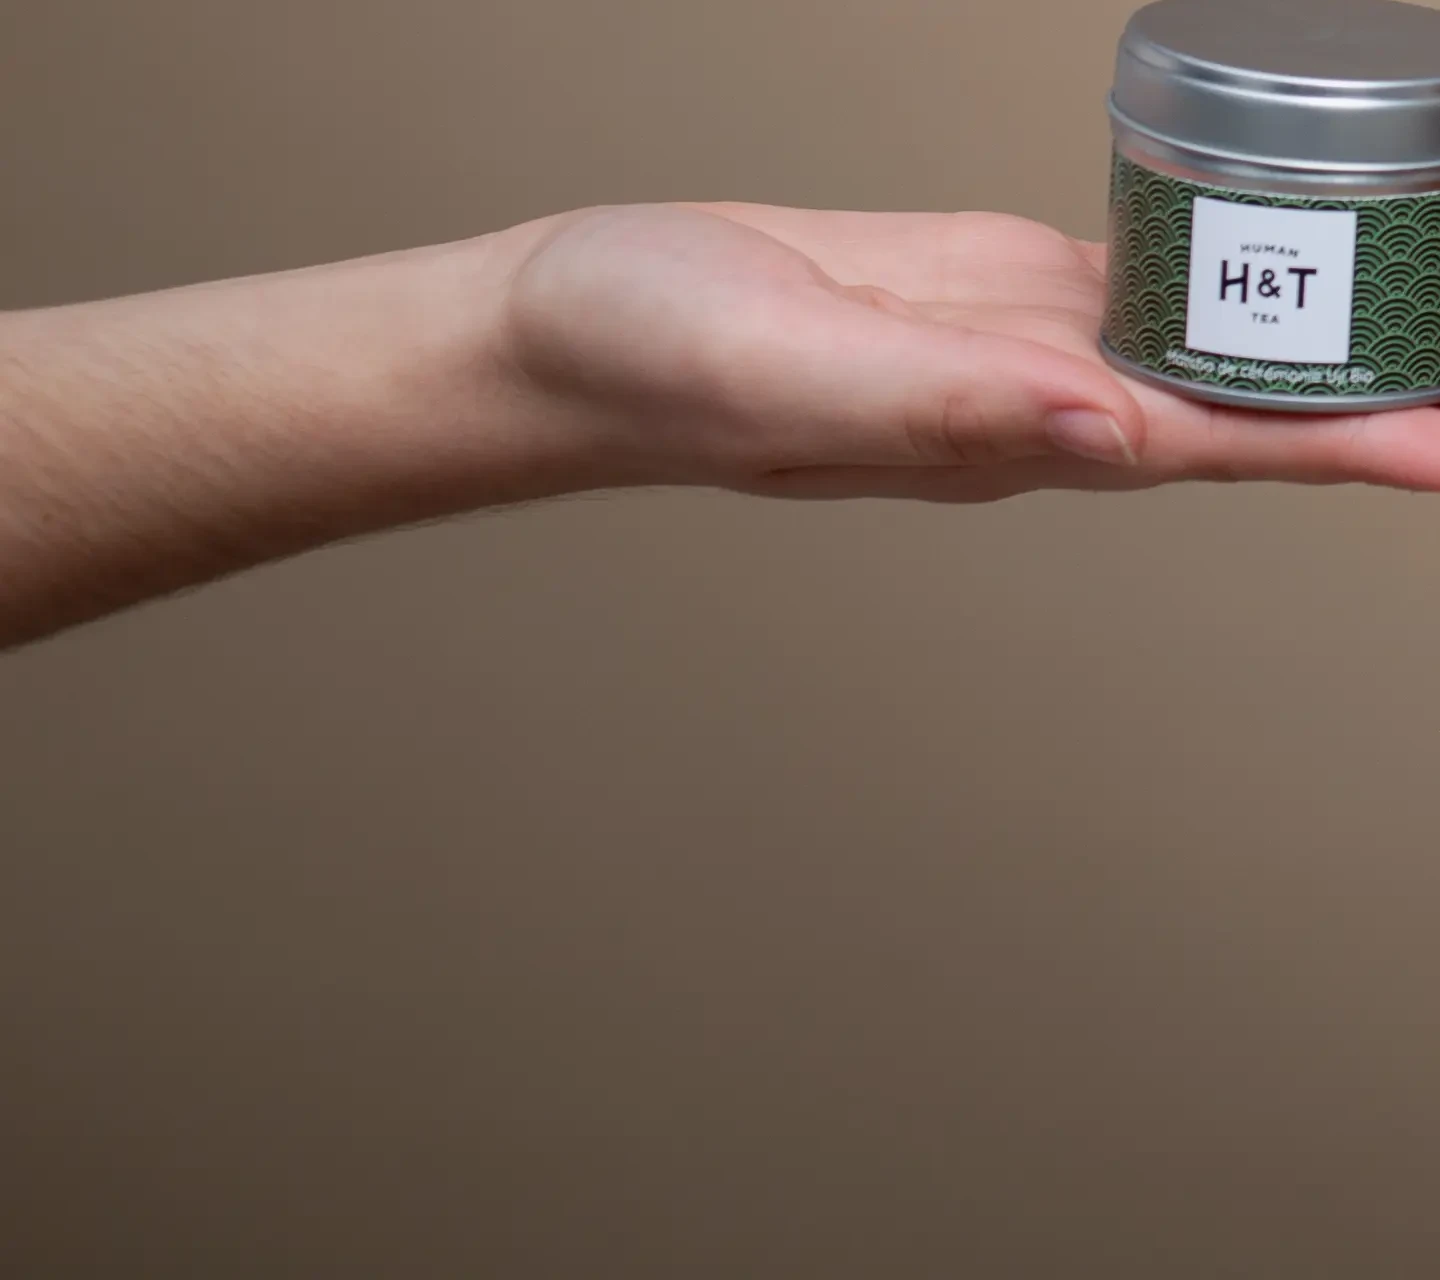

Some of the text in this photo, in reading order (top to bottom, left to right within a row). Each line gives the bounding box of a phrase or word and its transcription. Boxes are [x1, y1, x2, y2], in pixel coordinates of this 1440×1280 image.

[1240, 244, 1299, 258] HUMAN
[1219, 259, 1318, 309] H&T
[1251, 312, 1280, 324] TEA
